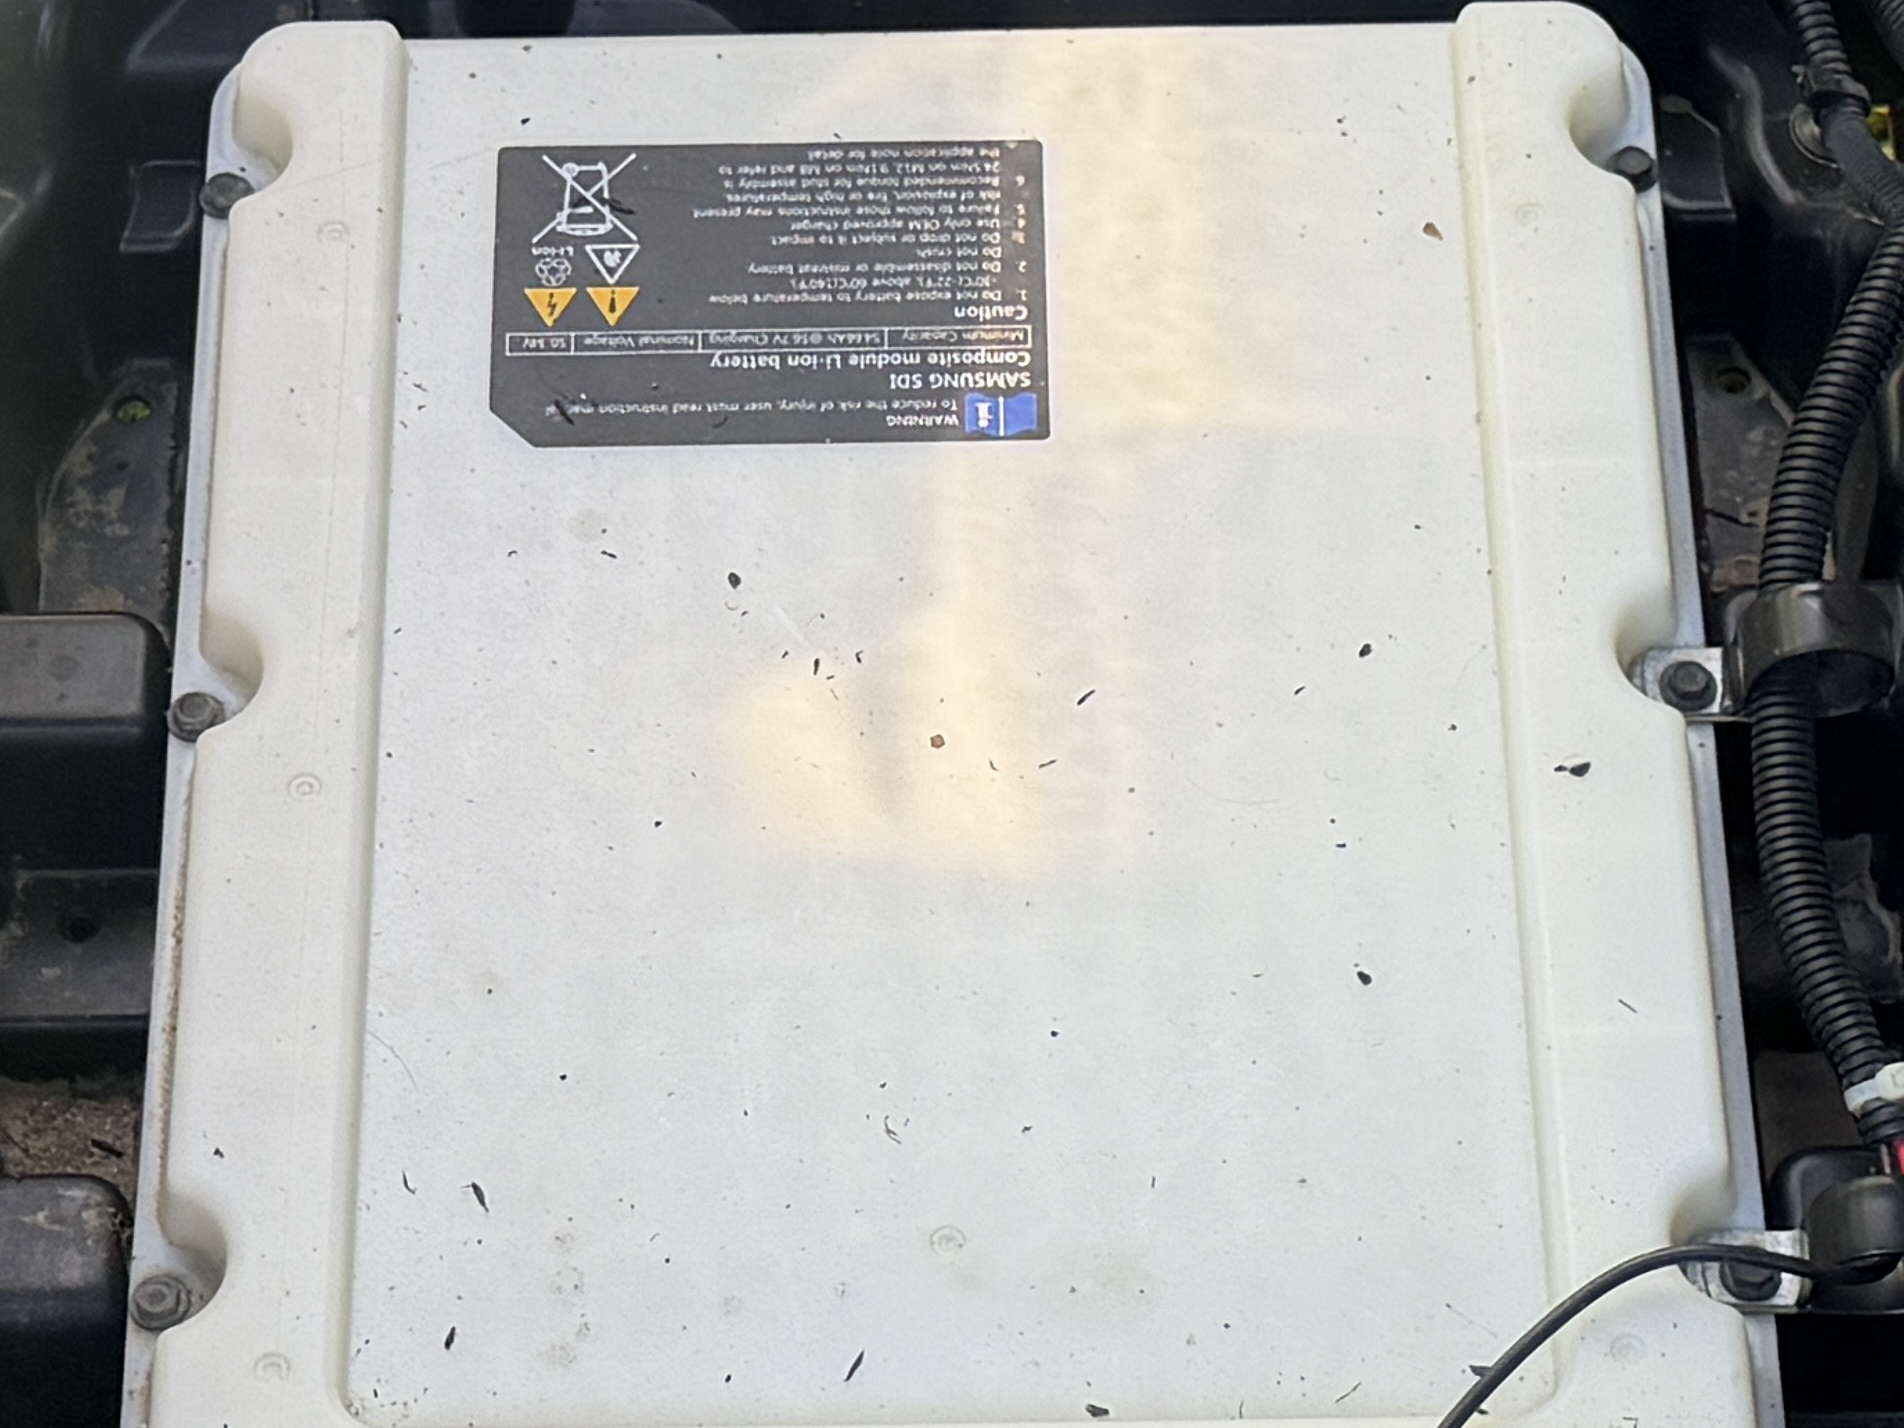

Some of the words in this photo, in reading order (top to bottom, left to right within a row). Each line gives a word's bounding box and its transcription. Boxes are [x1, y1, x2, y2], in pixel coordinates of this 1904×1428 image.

[954, 305, 1028, 321] Caution
[710, 350, 780, 370] battery
[849, 353, 920, 369] module
[928, 348, 1030, 367] Composite
[890, 374, 922, 389] SDI
[929, 372, 1031, 389] SAMSUNG
